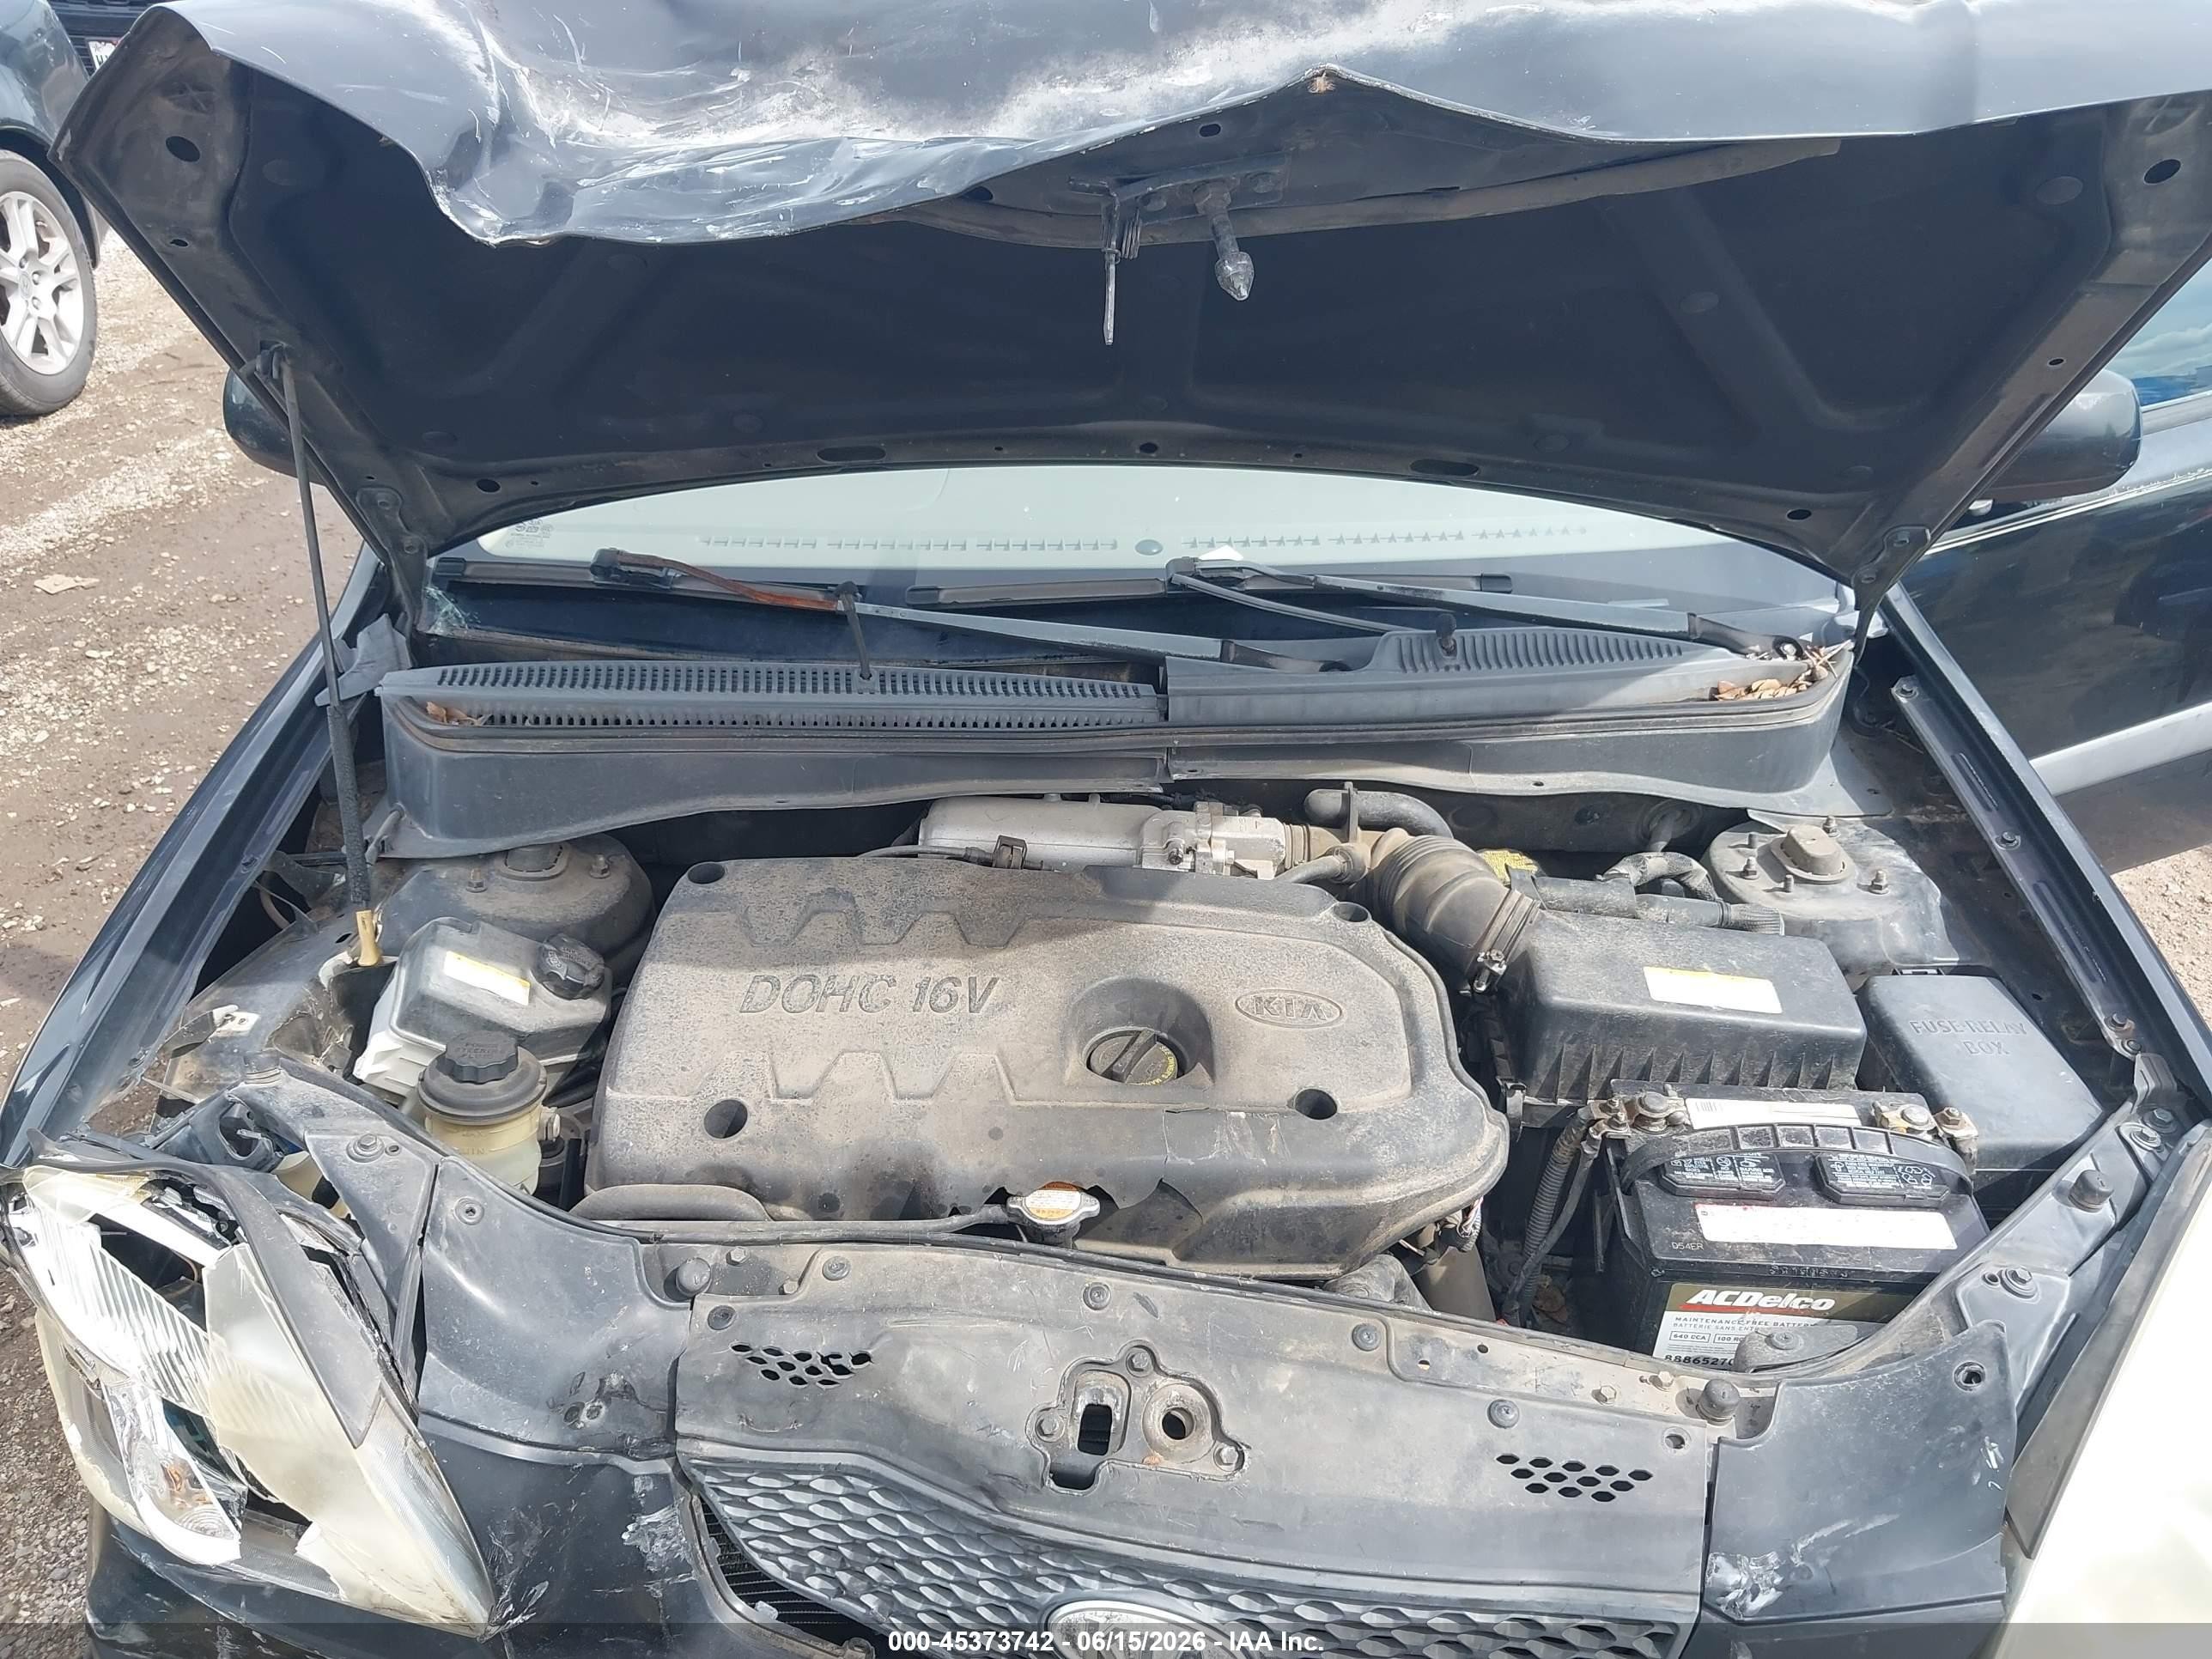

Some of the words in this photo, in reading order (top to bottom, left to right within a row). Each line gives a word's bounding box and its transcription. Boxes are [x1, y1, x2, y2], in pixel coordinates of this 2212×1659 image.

[739, 974, 897, 1014] DOHC
[912, 975, 1000, 1013] 16V
[1254, 995, 1328, 1021] KIA
[1962, 1041, 2010, 1055] BOX
[1686, 1290, 1836, 1310] ACDelco
